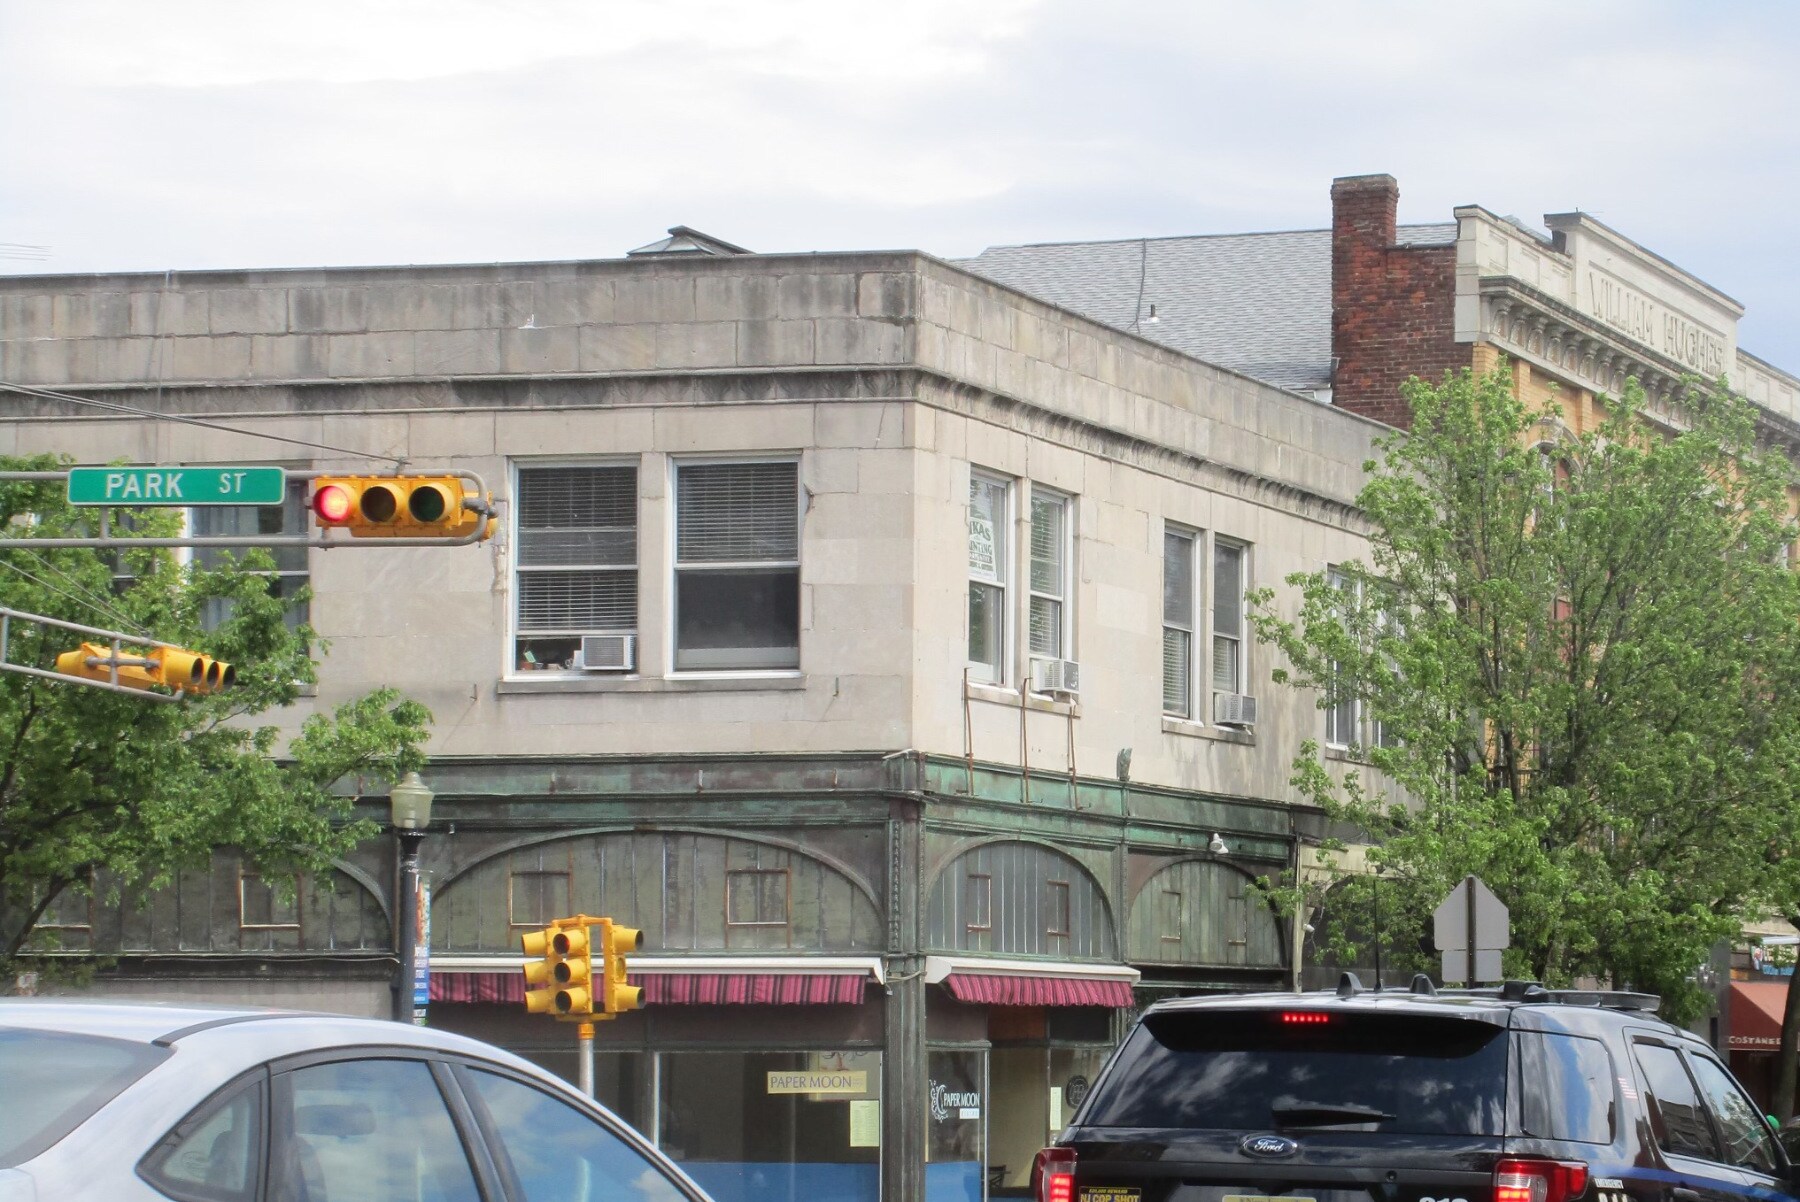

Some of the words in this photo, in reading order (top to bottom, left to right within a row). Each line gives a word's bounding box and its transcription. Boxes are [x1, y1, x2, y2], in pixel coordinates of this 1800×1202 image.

[1589, 271, 1655, 346] WILLIAM
[1663, 312, 1724, 378] HUGHES
[106, 473, 184, 498] PARK
[219, 472, 247, 494] ST
[770, 1076, 806, 1088] PAPER
[809, 1075, 852, 1089] MOON
[943, 1092, 960, 1107] PAPER
[960, 1092, 980, 1107] MOON
[1254, 1139, 1285, 1153] Ford
